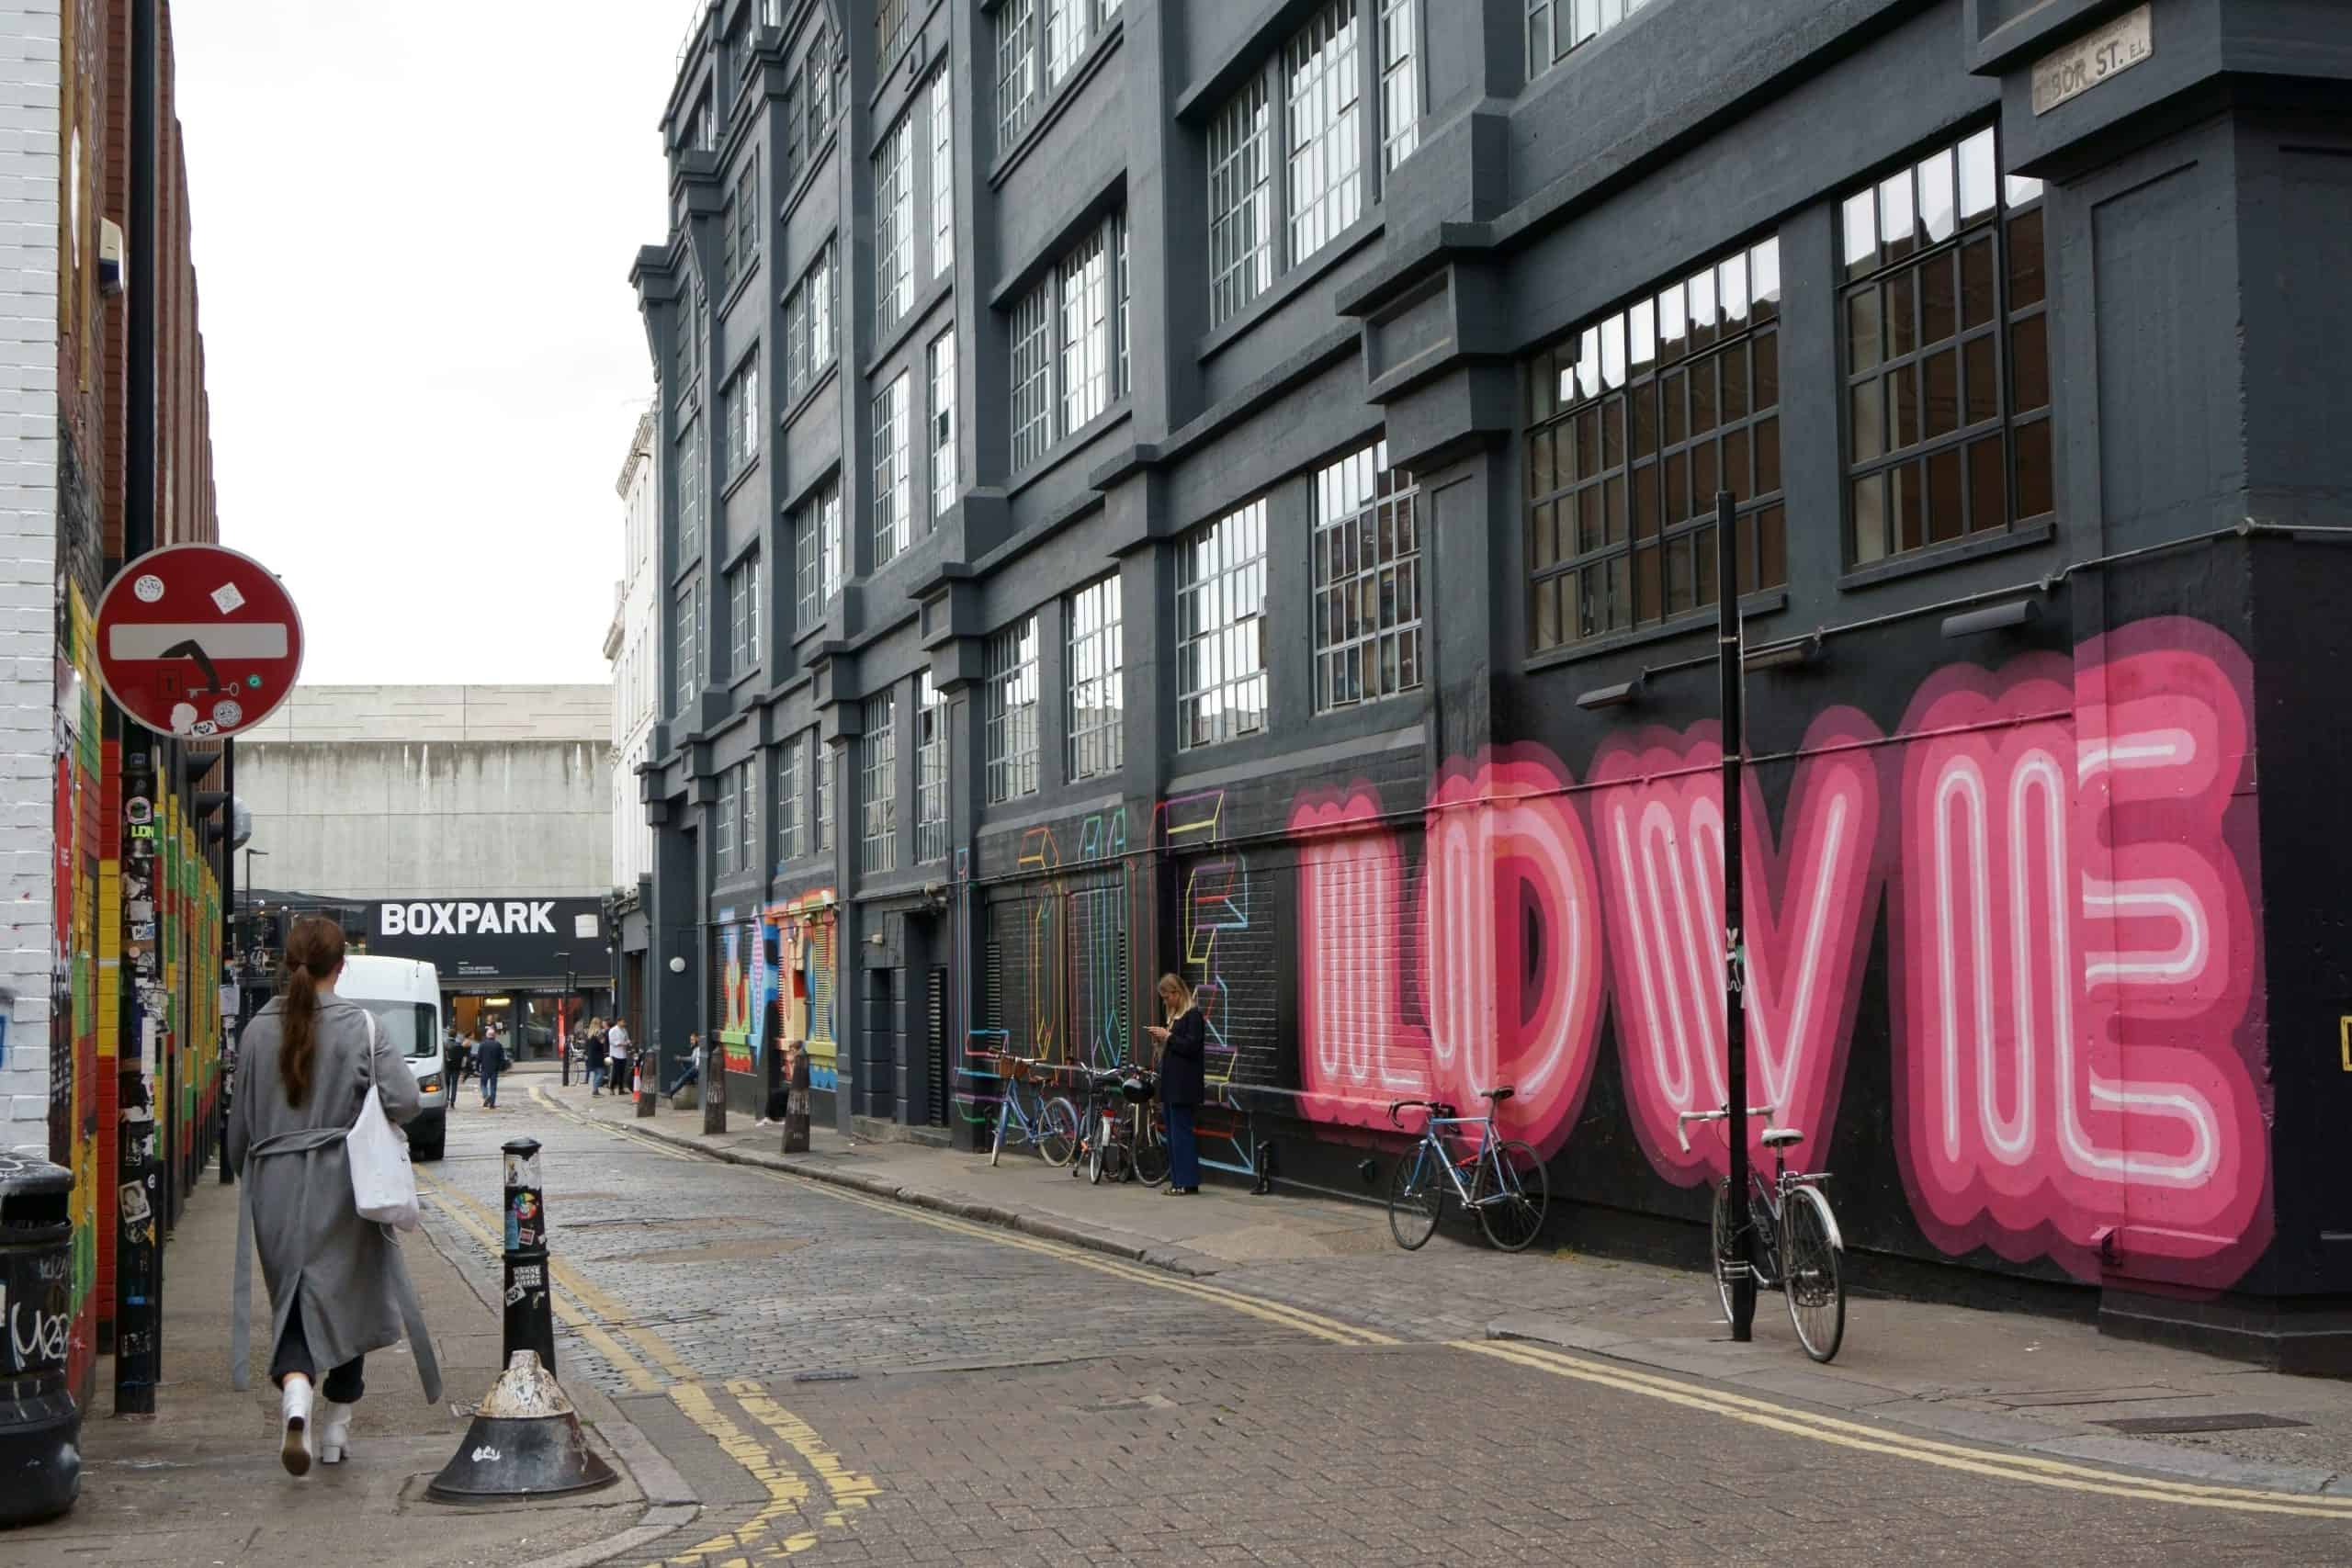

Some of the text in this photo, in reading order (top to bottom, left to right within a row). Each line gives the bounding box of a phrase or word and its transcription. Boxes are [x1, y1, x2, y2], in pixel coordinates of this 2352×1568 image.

[2096, 38, 2124, 76] ST.
[381, 902, 557, 936] BOXPARK
[1290, 614, 2277, 1295] LOVE
